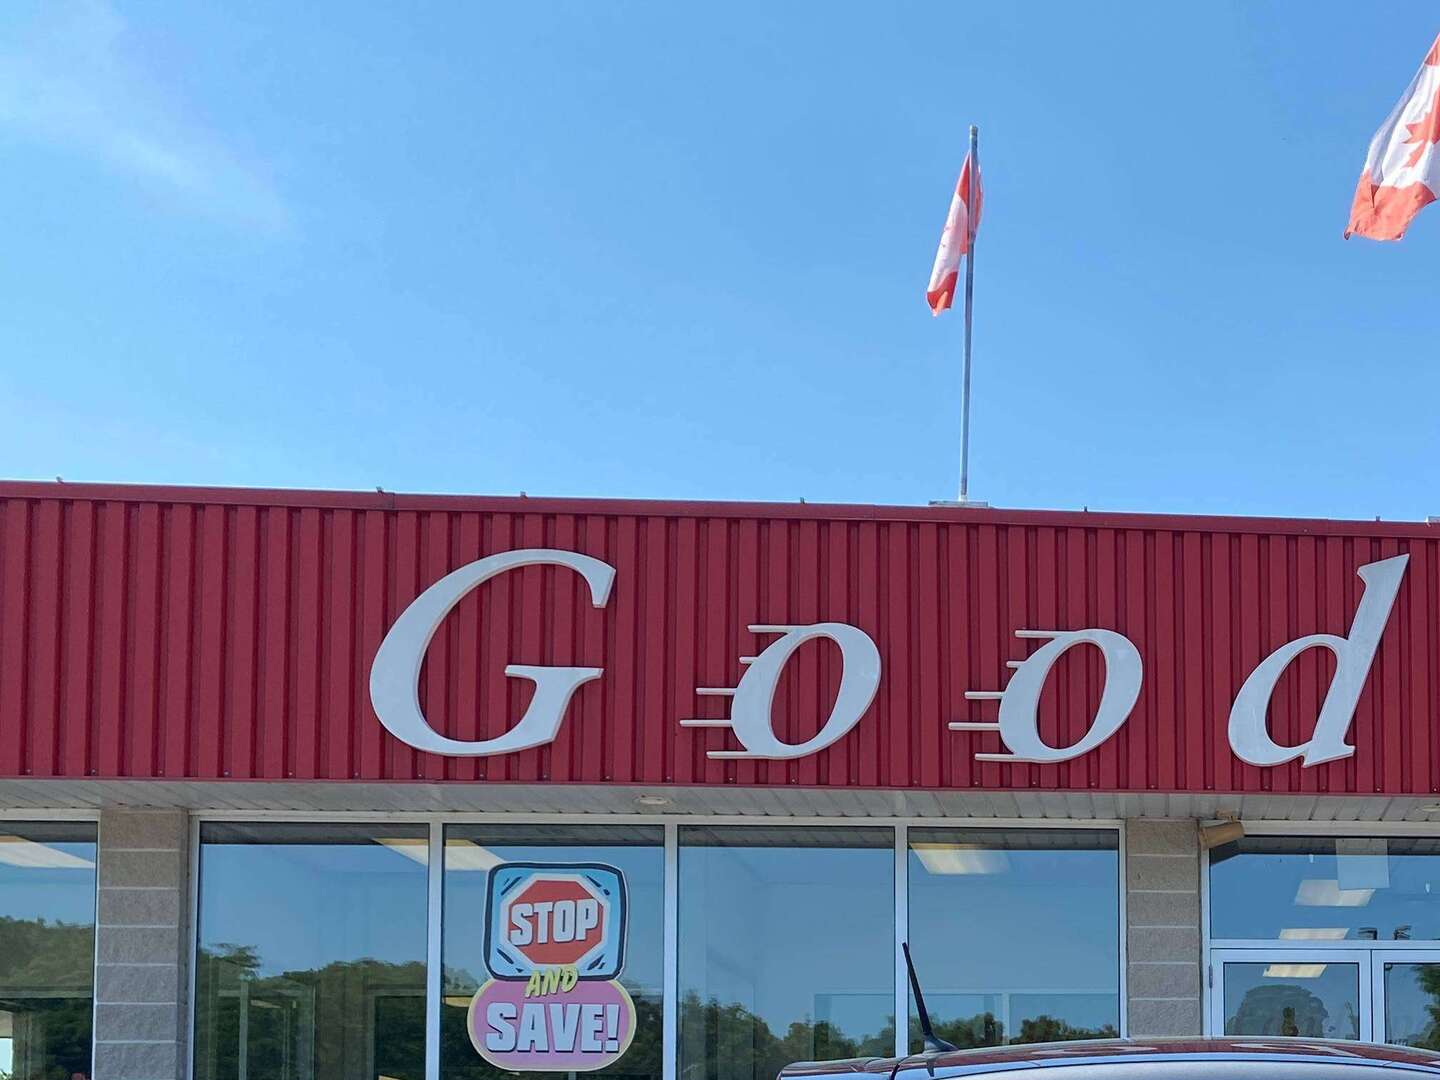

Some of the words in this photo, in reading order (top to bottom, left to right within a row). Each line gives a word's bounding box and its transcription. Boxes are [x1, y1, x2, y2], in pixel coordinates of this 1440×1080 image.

[510, 898, 600, 946] STOP
[525, 967, 579, 998] AND
[486, 1002, 621, 1053] SAVE!
